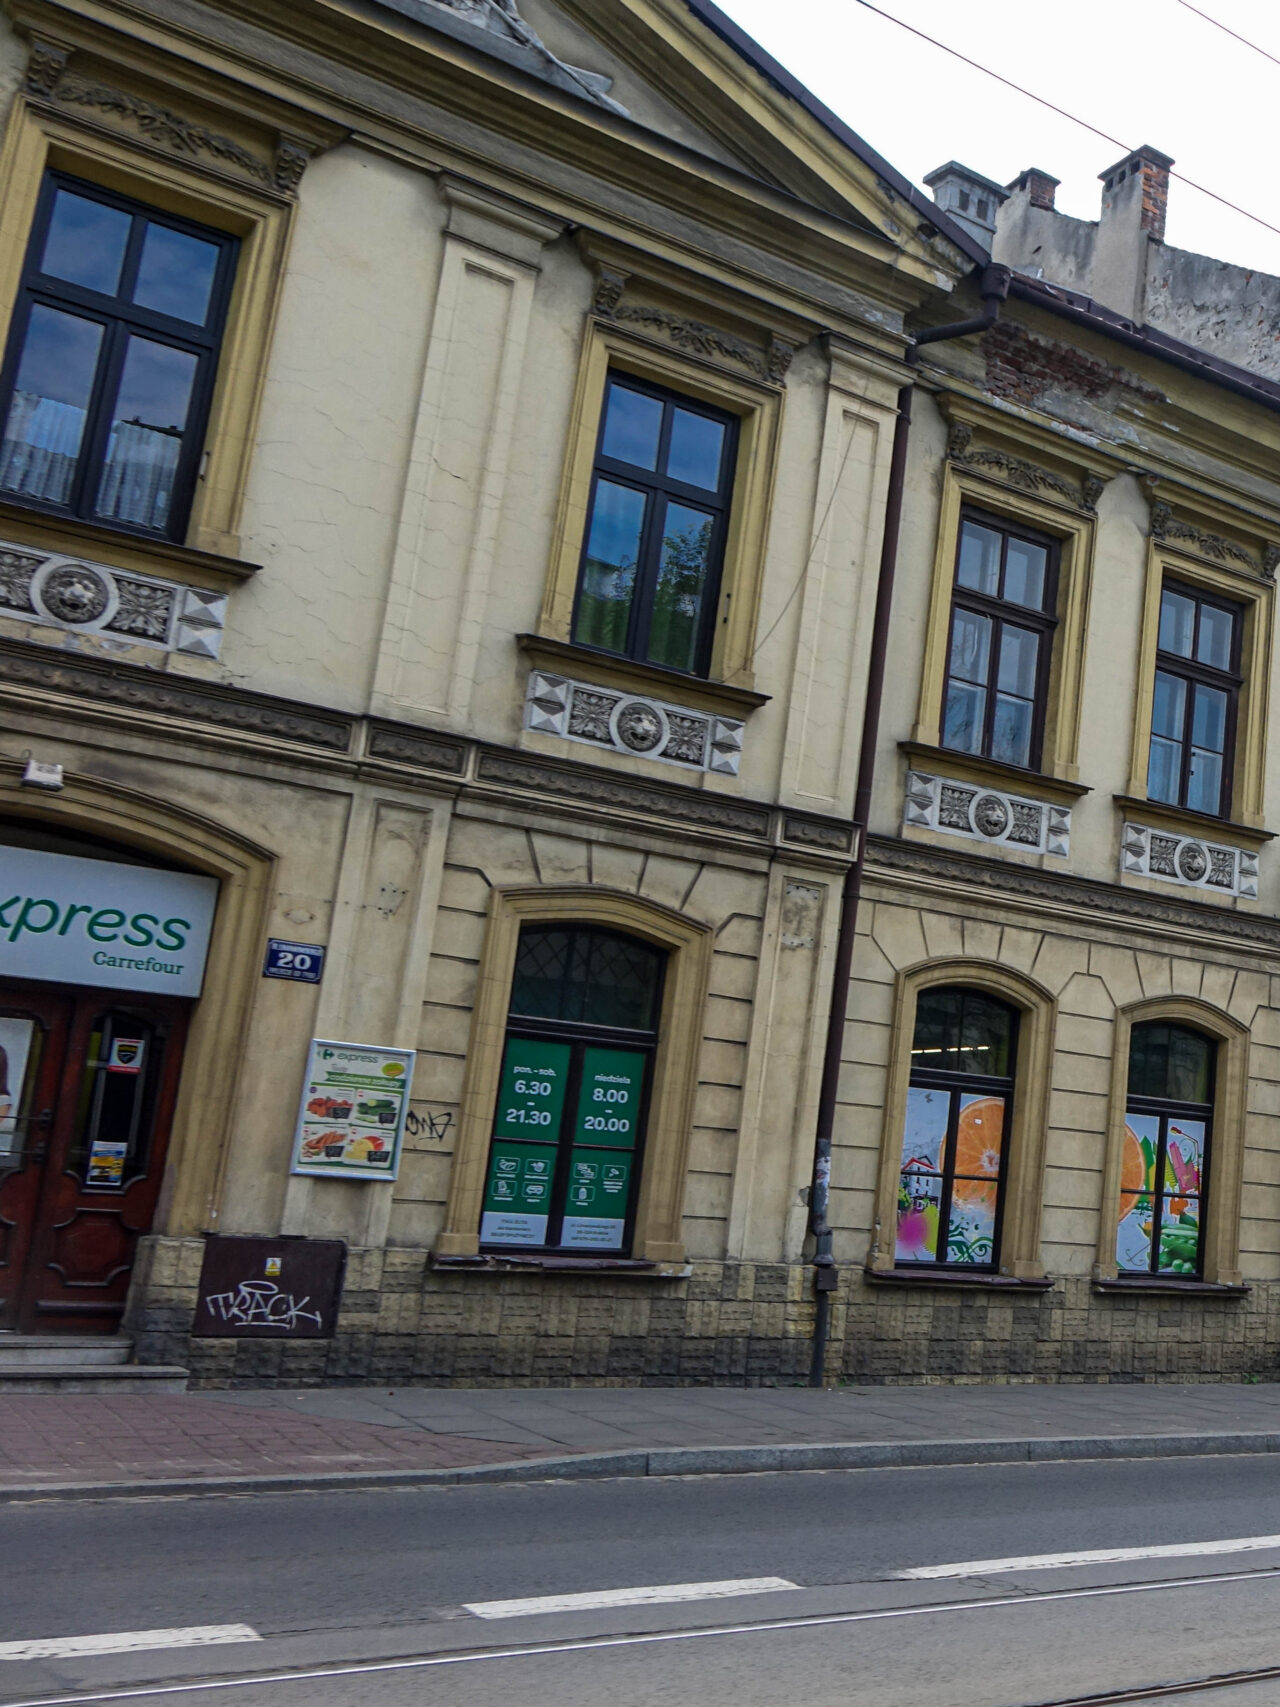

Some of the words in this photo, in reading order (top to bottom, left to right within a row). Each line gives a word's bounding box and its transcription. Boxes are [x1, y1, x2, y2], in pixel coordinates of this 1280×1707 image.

[92, 951, 184, 975] Carrefour
[276, 951, 312, 970] 20
[336, 1052, 379, 1064] express
[514, 1079, 552, 1096] 6.30
[592, 1087, 629, 1104] 8.00
[505, 1108, 552, 1125] 21.30
[583, 1115, 630, 1133] 20.00
